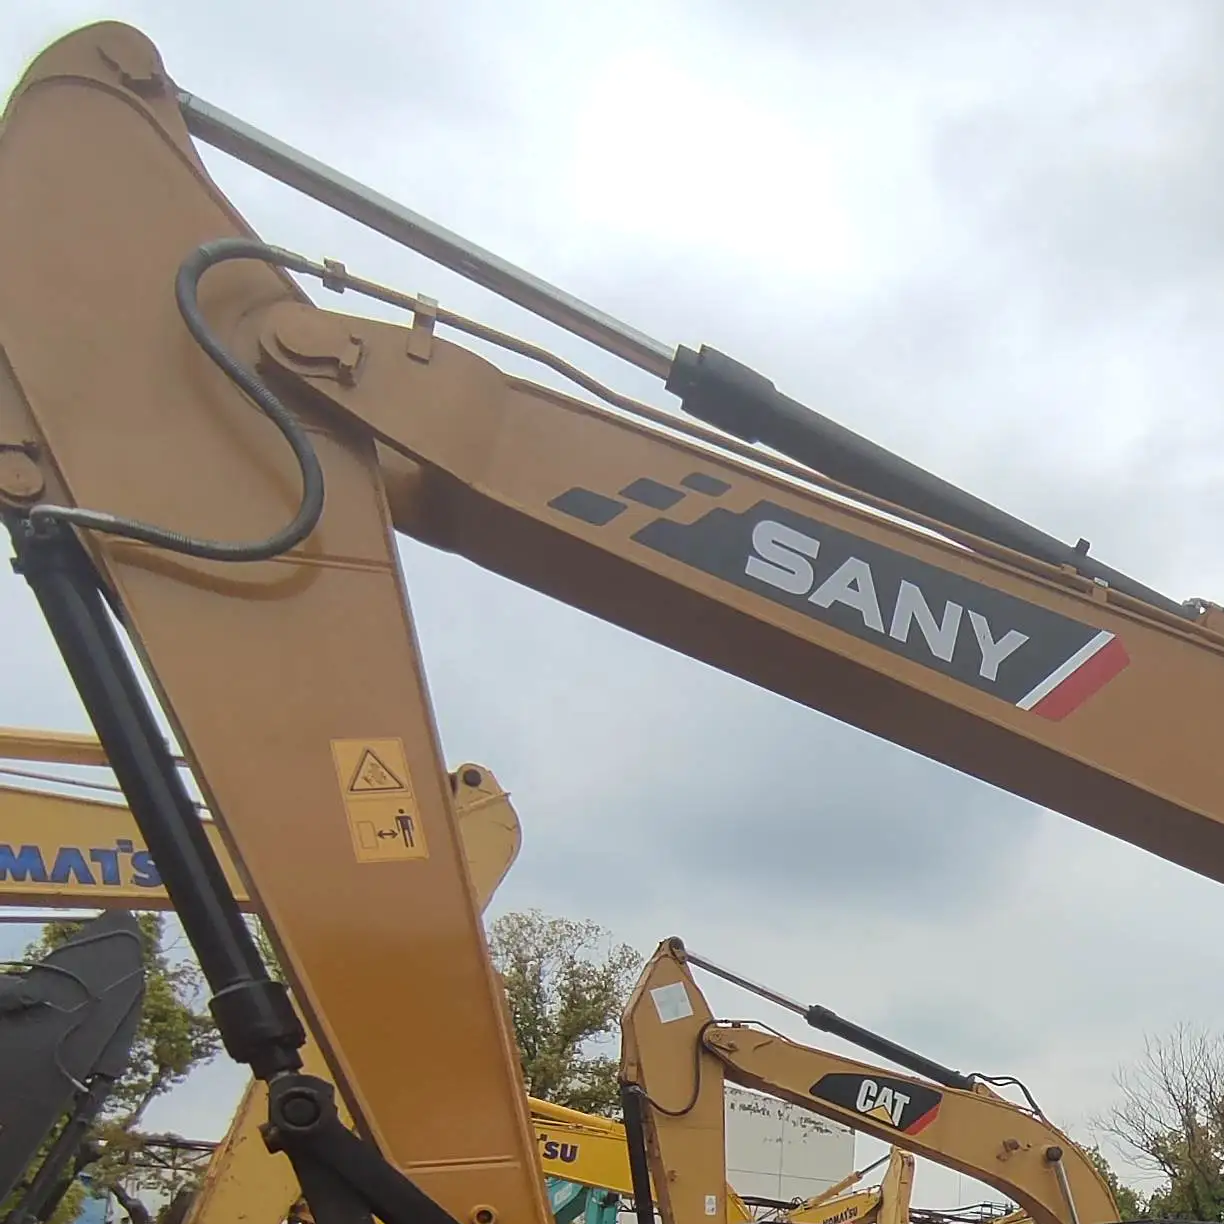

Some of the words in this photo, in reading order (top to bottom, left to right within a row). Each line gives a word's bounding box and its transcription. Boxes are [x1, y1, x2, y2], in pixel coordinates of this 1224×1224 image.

[745, 519, 1030, 682] SANY
[856, 1079, 911, 1127] CAT
[537, 1133, 579, 1164] SU
